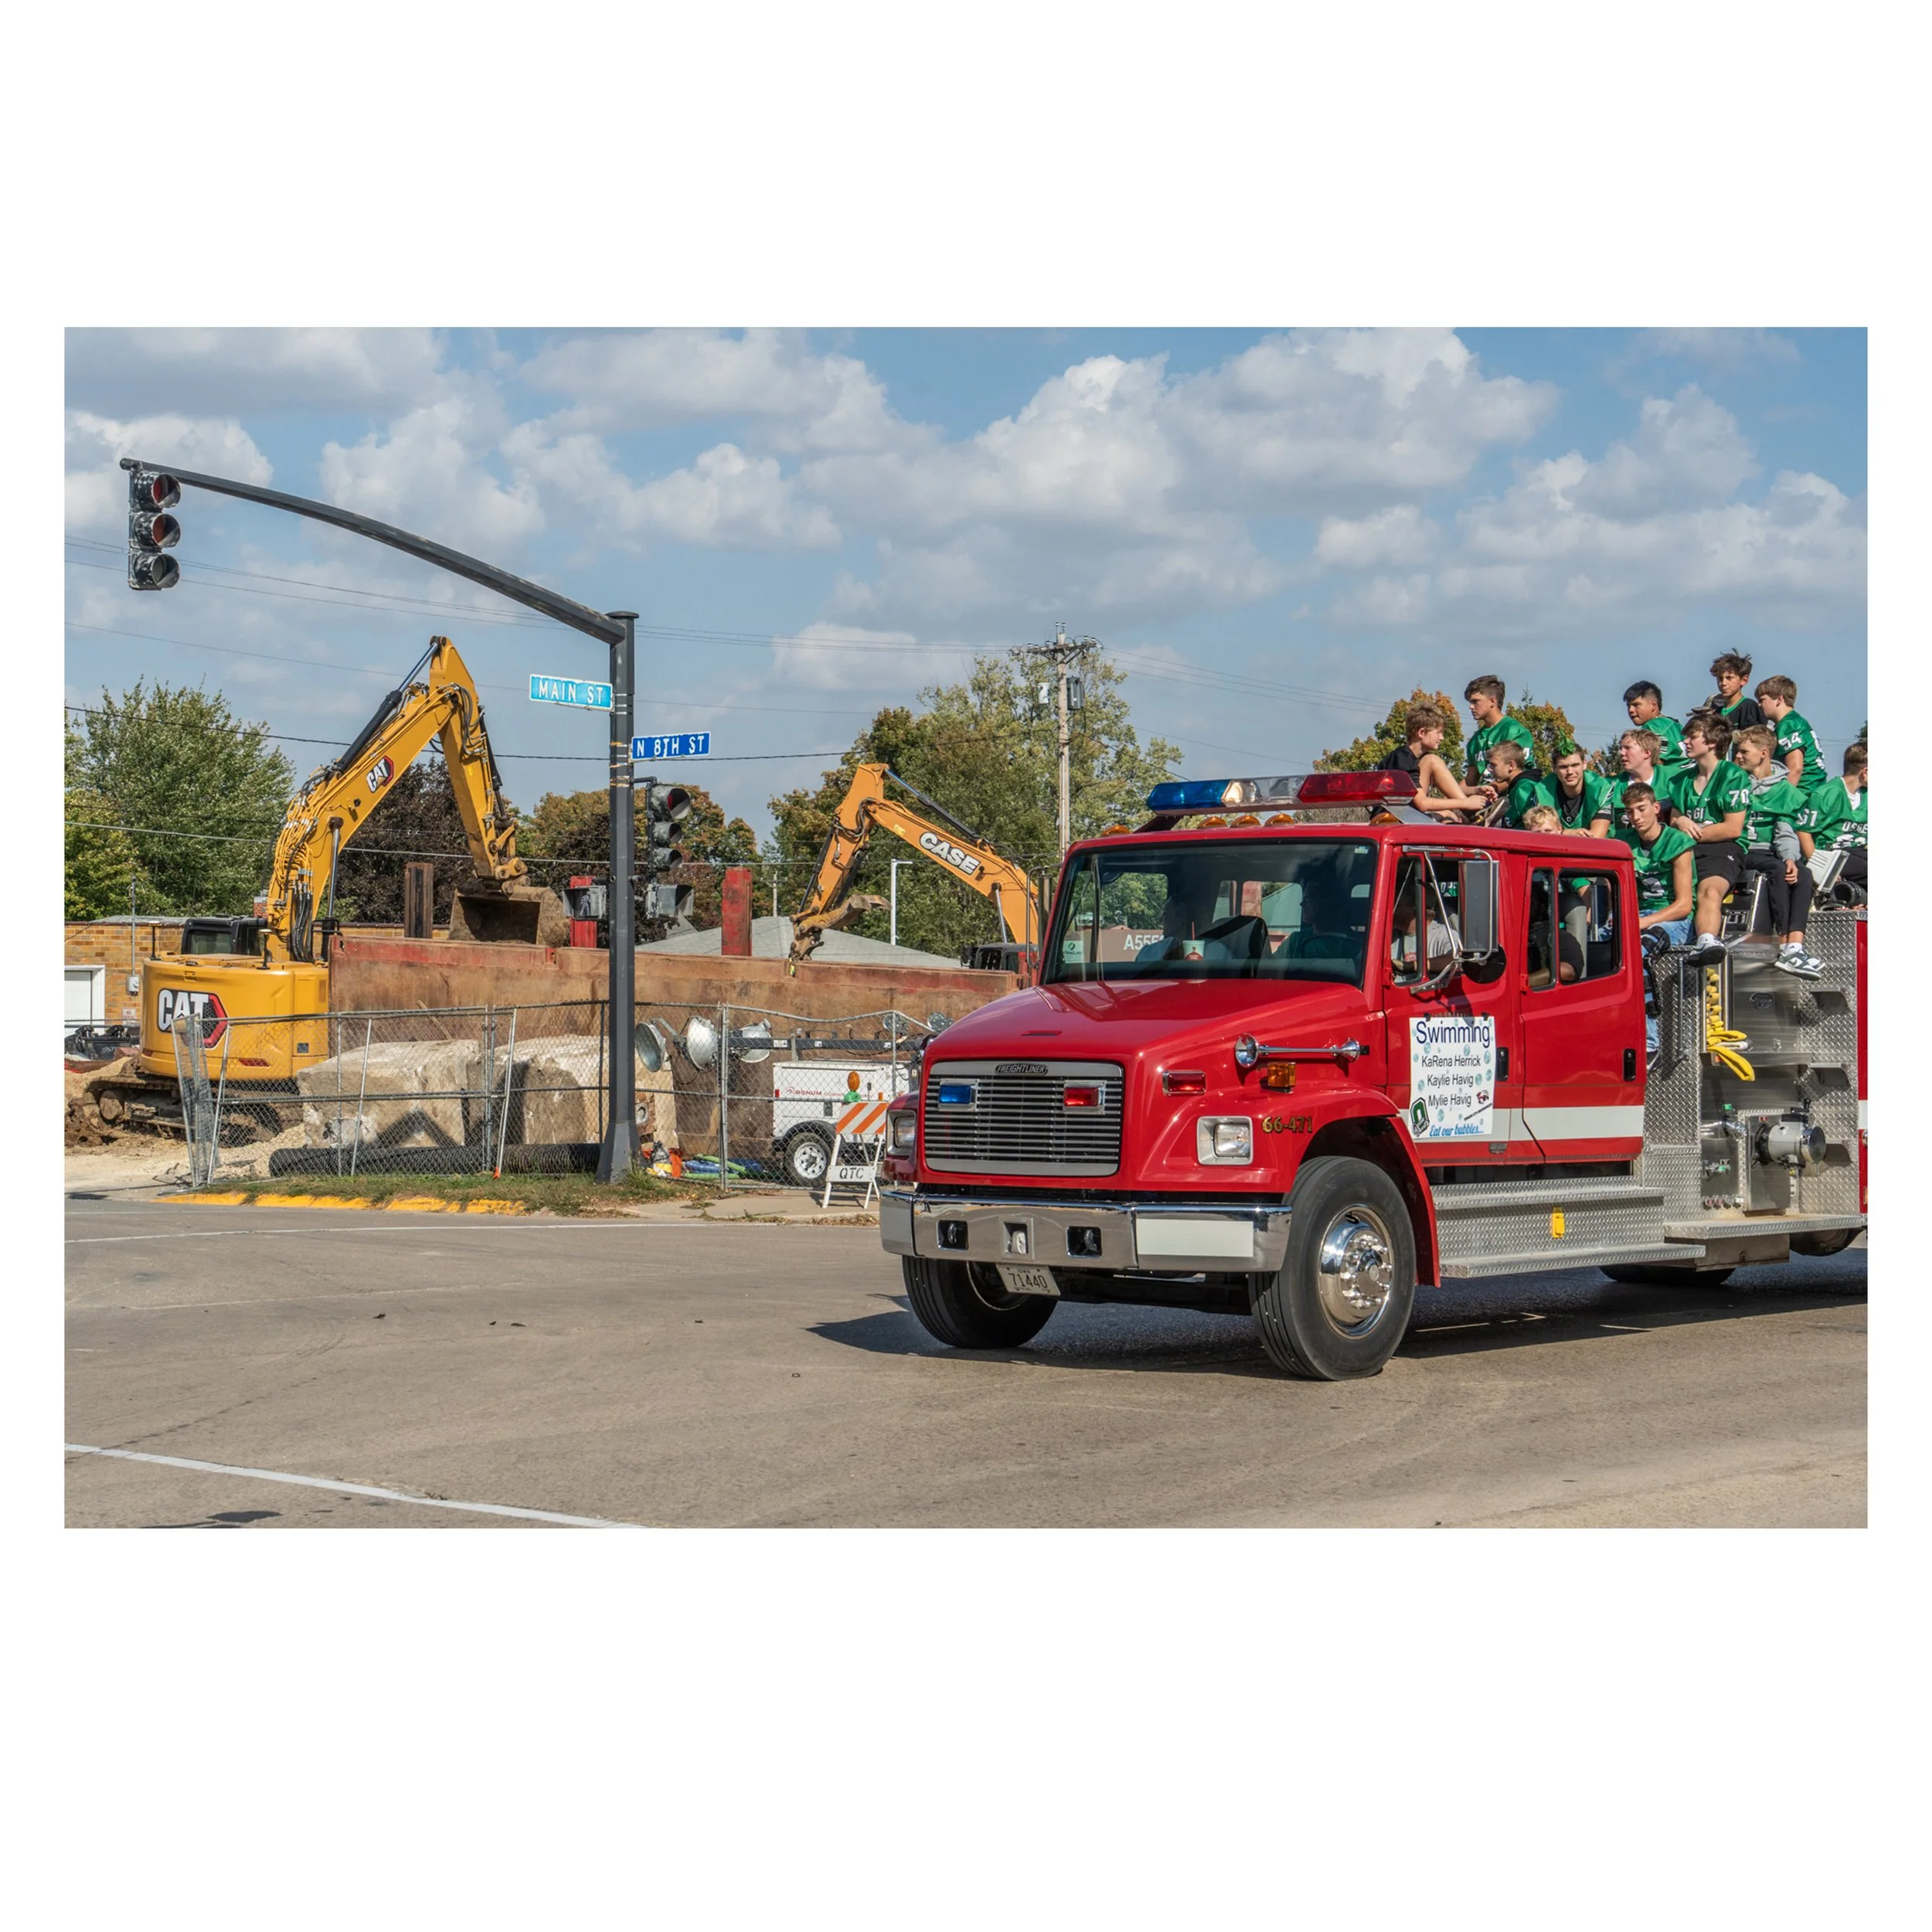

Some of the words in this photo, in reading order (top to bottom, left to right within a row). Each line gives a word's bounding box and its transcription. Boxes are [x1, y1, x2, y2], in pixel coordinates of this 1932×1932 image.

[539, 680, 576, 702] MAIN
[587, 685, 604, 704] ST
[637, 740, 645, 757] N
[654, 738, 679, 757] 8TH
[689, 736, 705, 753] ST
[1778, 732, 1803, 751] 54
[366, 758, 389, 792] CAT
[919, 832, 981, 876] CASE
[158, 988, 209, 1032] CAT
[1416, 1020, 1491, 1049] Swimming
[997, 1064, 1045, 1073] FREIGHTLINER
[1422, 1055, 1453, 1067] KaRena
[1454, 1054, 1481, 1067] Herrick
[1427, 1074, 1451, 1089] Kaylie
[1452, 1073, 1475, 1087] Havig
[1428, 1094, 1449, 1109] Mylie
[1451, 1093, 1472, 1107] Havig
[1262, 1116, 1313, 1134] 66-471
[1429, 1124, 1441, 1137] Eat
[839, 1167, 864, 1179] QTC
[1009, 1273, 1048, 1288] 71440
